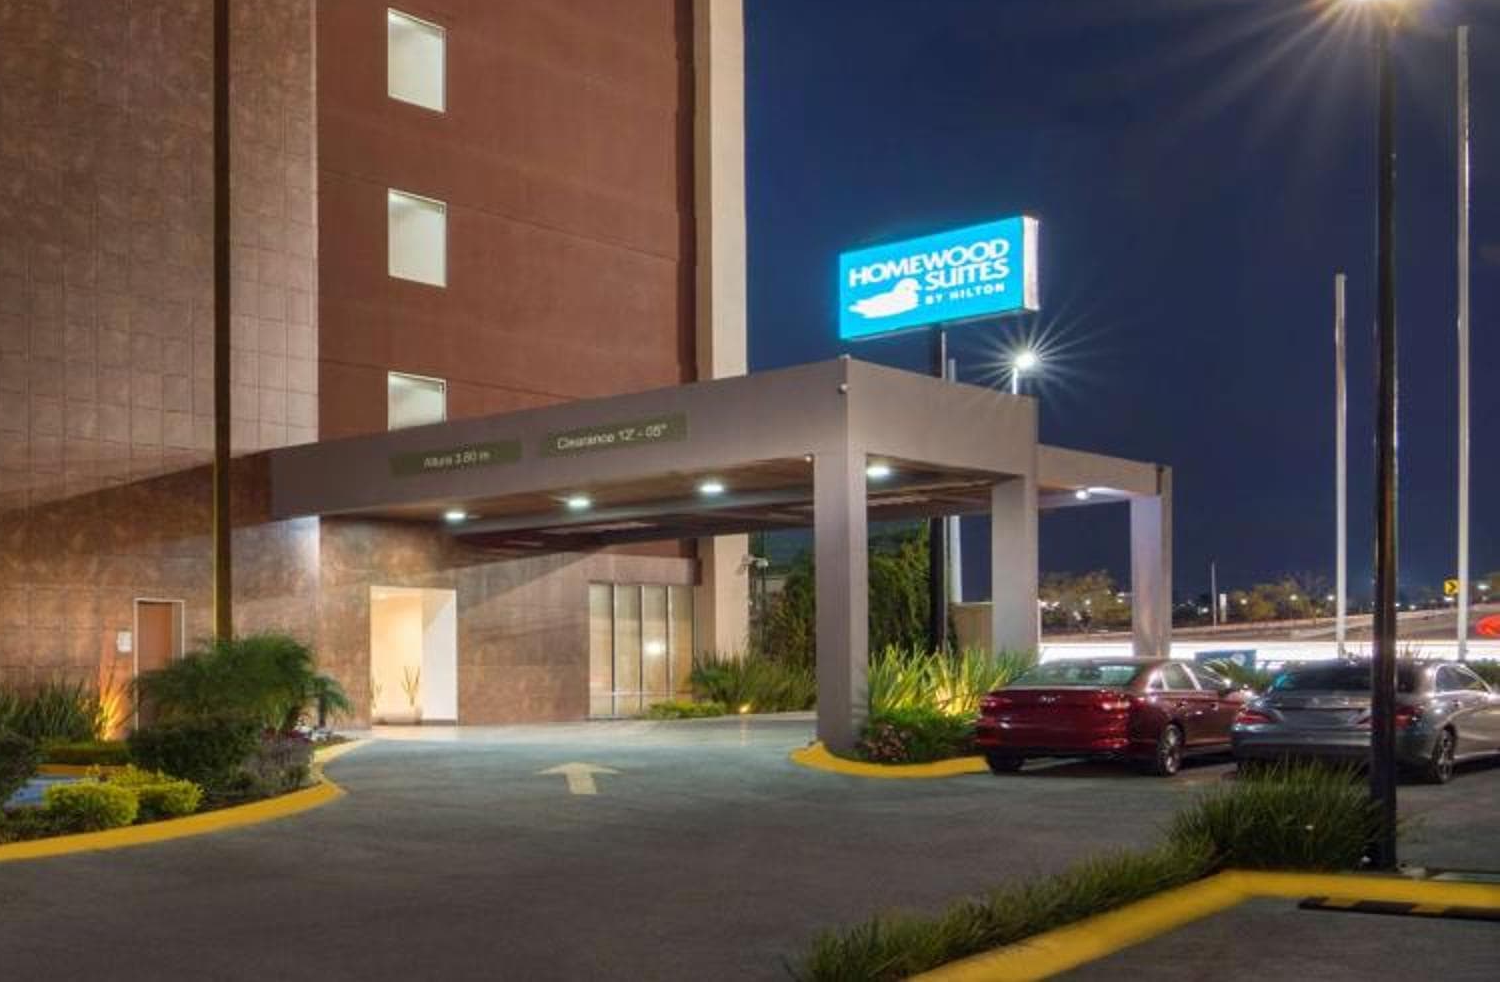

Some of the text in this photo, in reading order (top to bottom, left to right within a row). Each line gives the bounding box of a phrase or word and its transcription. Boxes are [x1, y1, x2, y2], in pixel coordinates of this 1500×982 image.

[850, 238, 1009, 287] HOMEWOOD
[925, 258, 1009, 291] SUITES
[925, 282, 1005, 306] BY HILTON
[557, 433, 615, 450] Clearance
